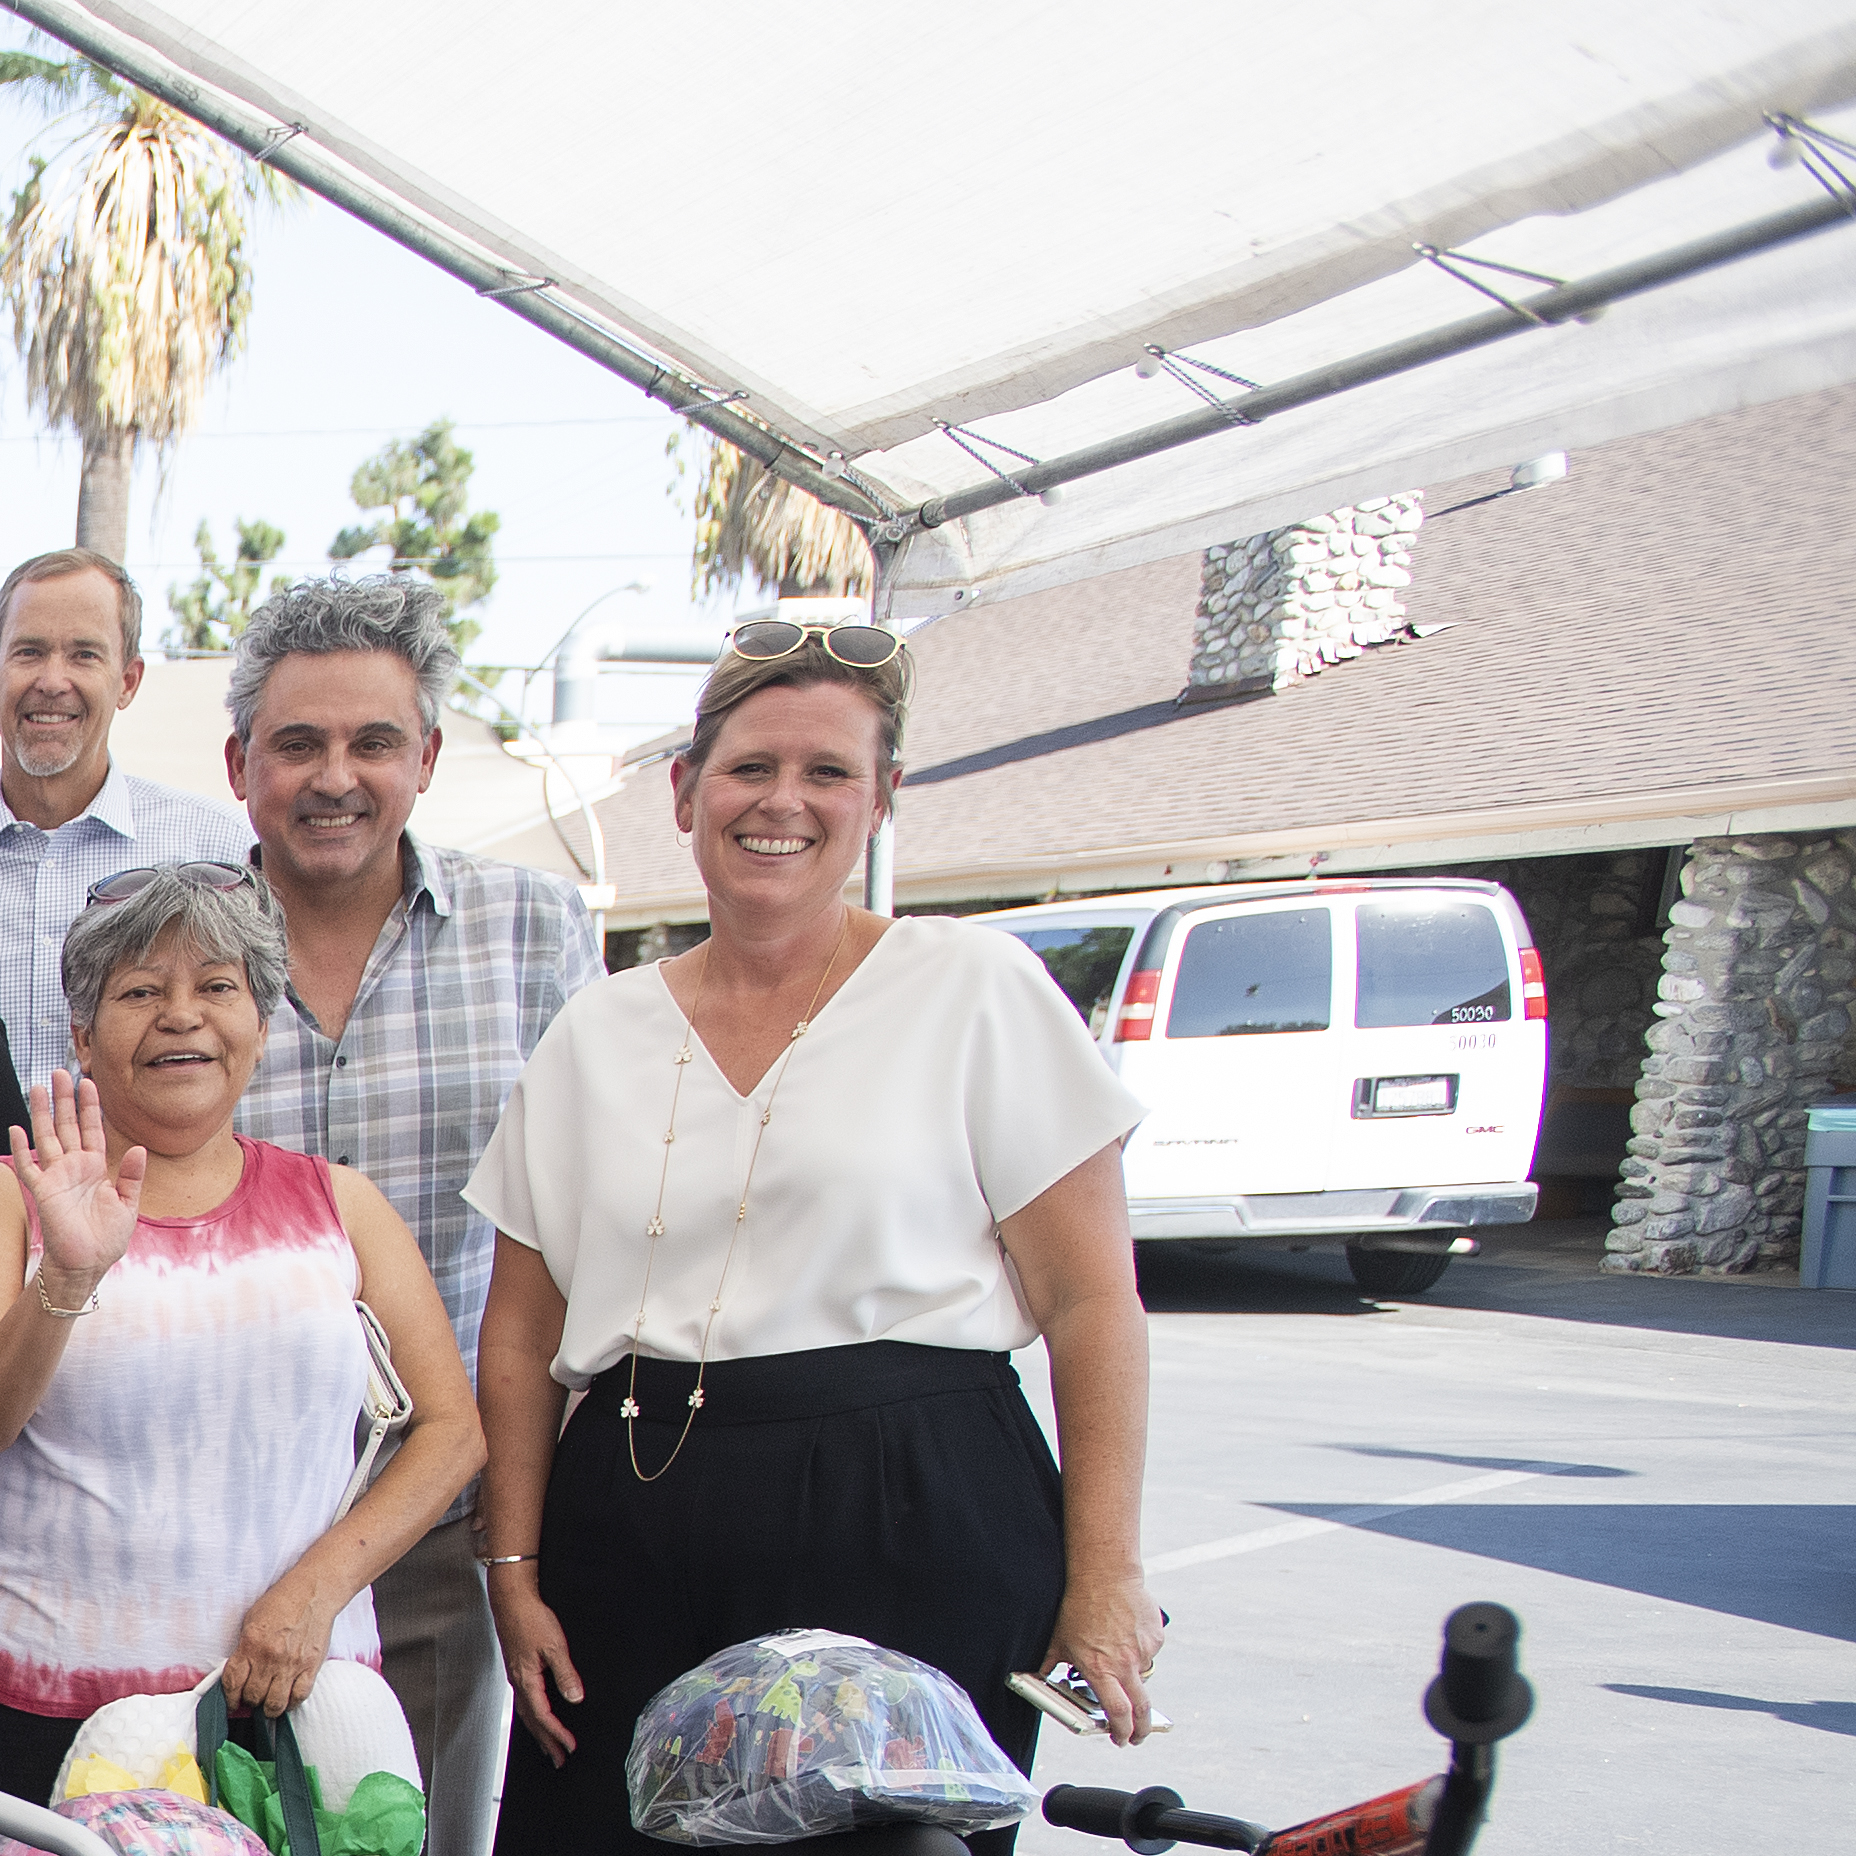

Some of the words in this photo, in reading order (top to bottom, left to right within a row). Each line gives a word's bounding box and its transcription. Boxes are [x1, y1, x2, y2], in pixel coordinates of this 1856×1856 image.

[1451, 1005, 1494, 1023] 50030
[1449, 1033, 1496, 1051] 50030
[1465, 1125, 1505, 1135] GMC
